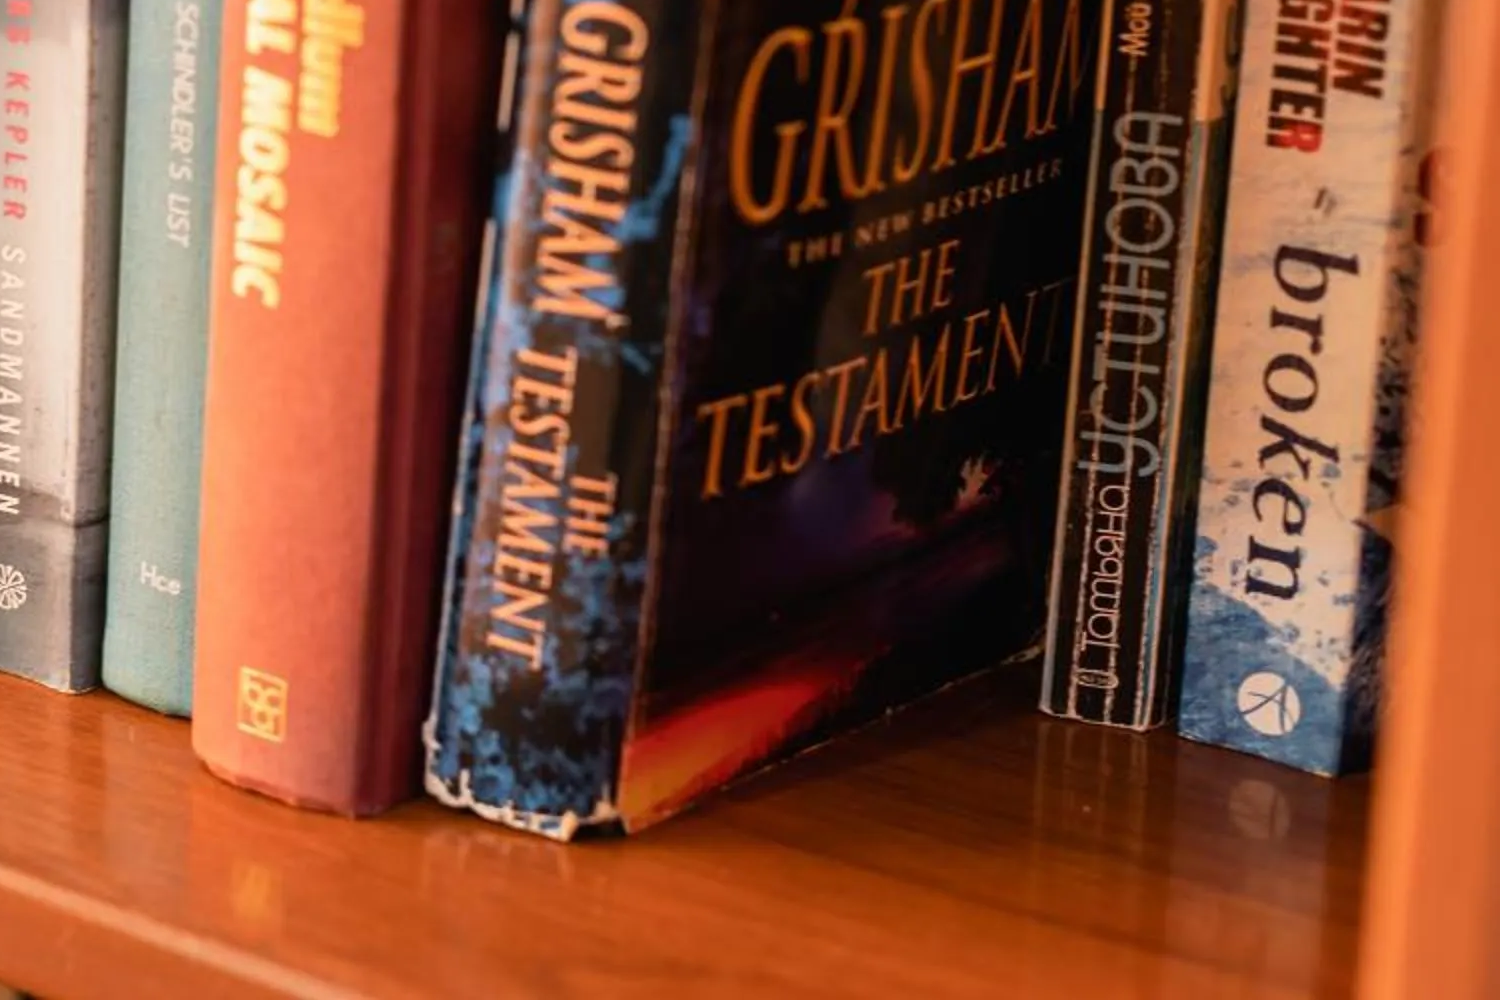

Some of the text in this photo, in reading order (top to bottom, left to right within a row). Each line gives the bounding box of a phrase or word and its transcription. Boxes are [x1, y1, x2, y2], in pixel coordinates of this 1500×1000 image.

[2, 70, 31, 221] KEPLER
[167, 0, 200, 182] SCHINDLER'S
[165, 193, 192, 248] LIST
[232, 65, 296, 309] MOSAIC
[787, 158, 1063, 269] THE NEW BESTSELLER
[862, 239, 961, 337] THE
[697, 276, 1075, 502] TESTAMENT
[1243, 242, 1361, 602] broken
[486, 344, 579, 673] TESTAMENT
[562, 470, 619, 559] THE
